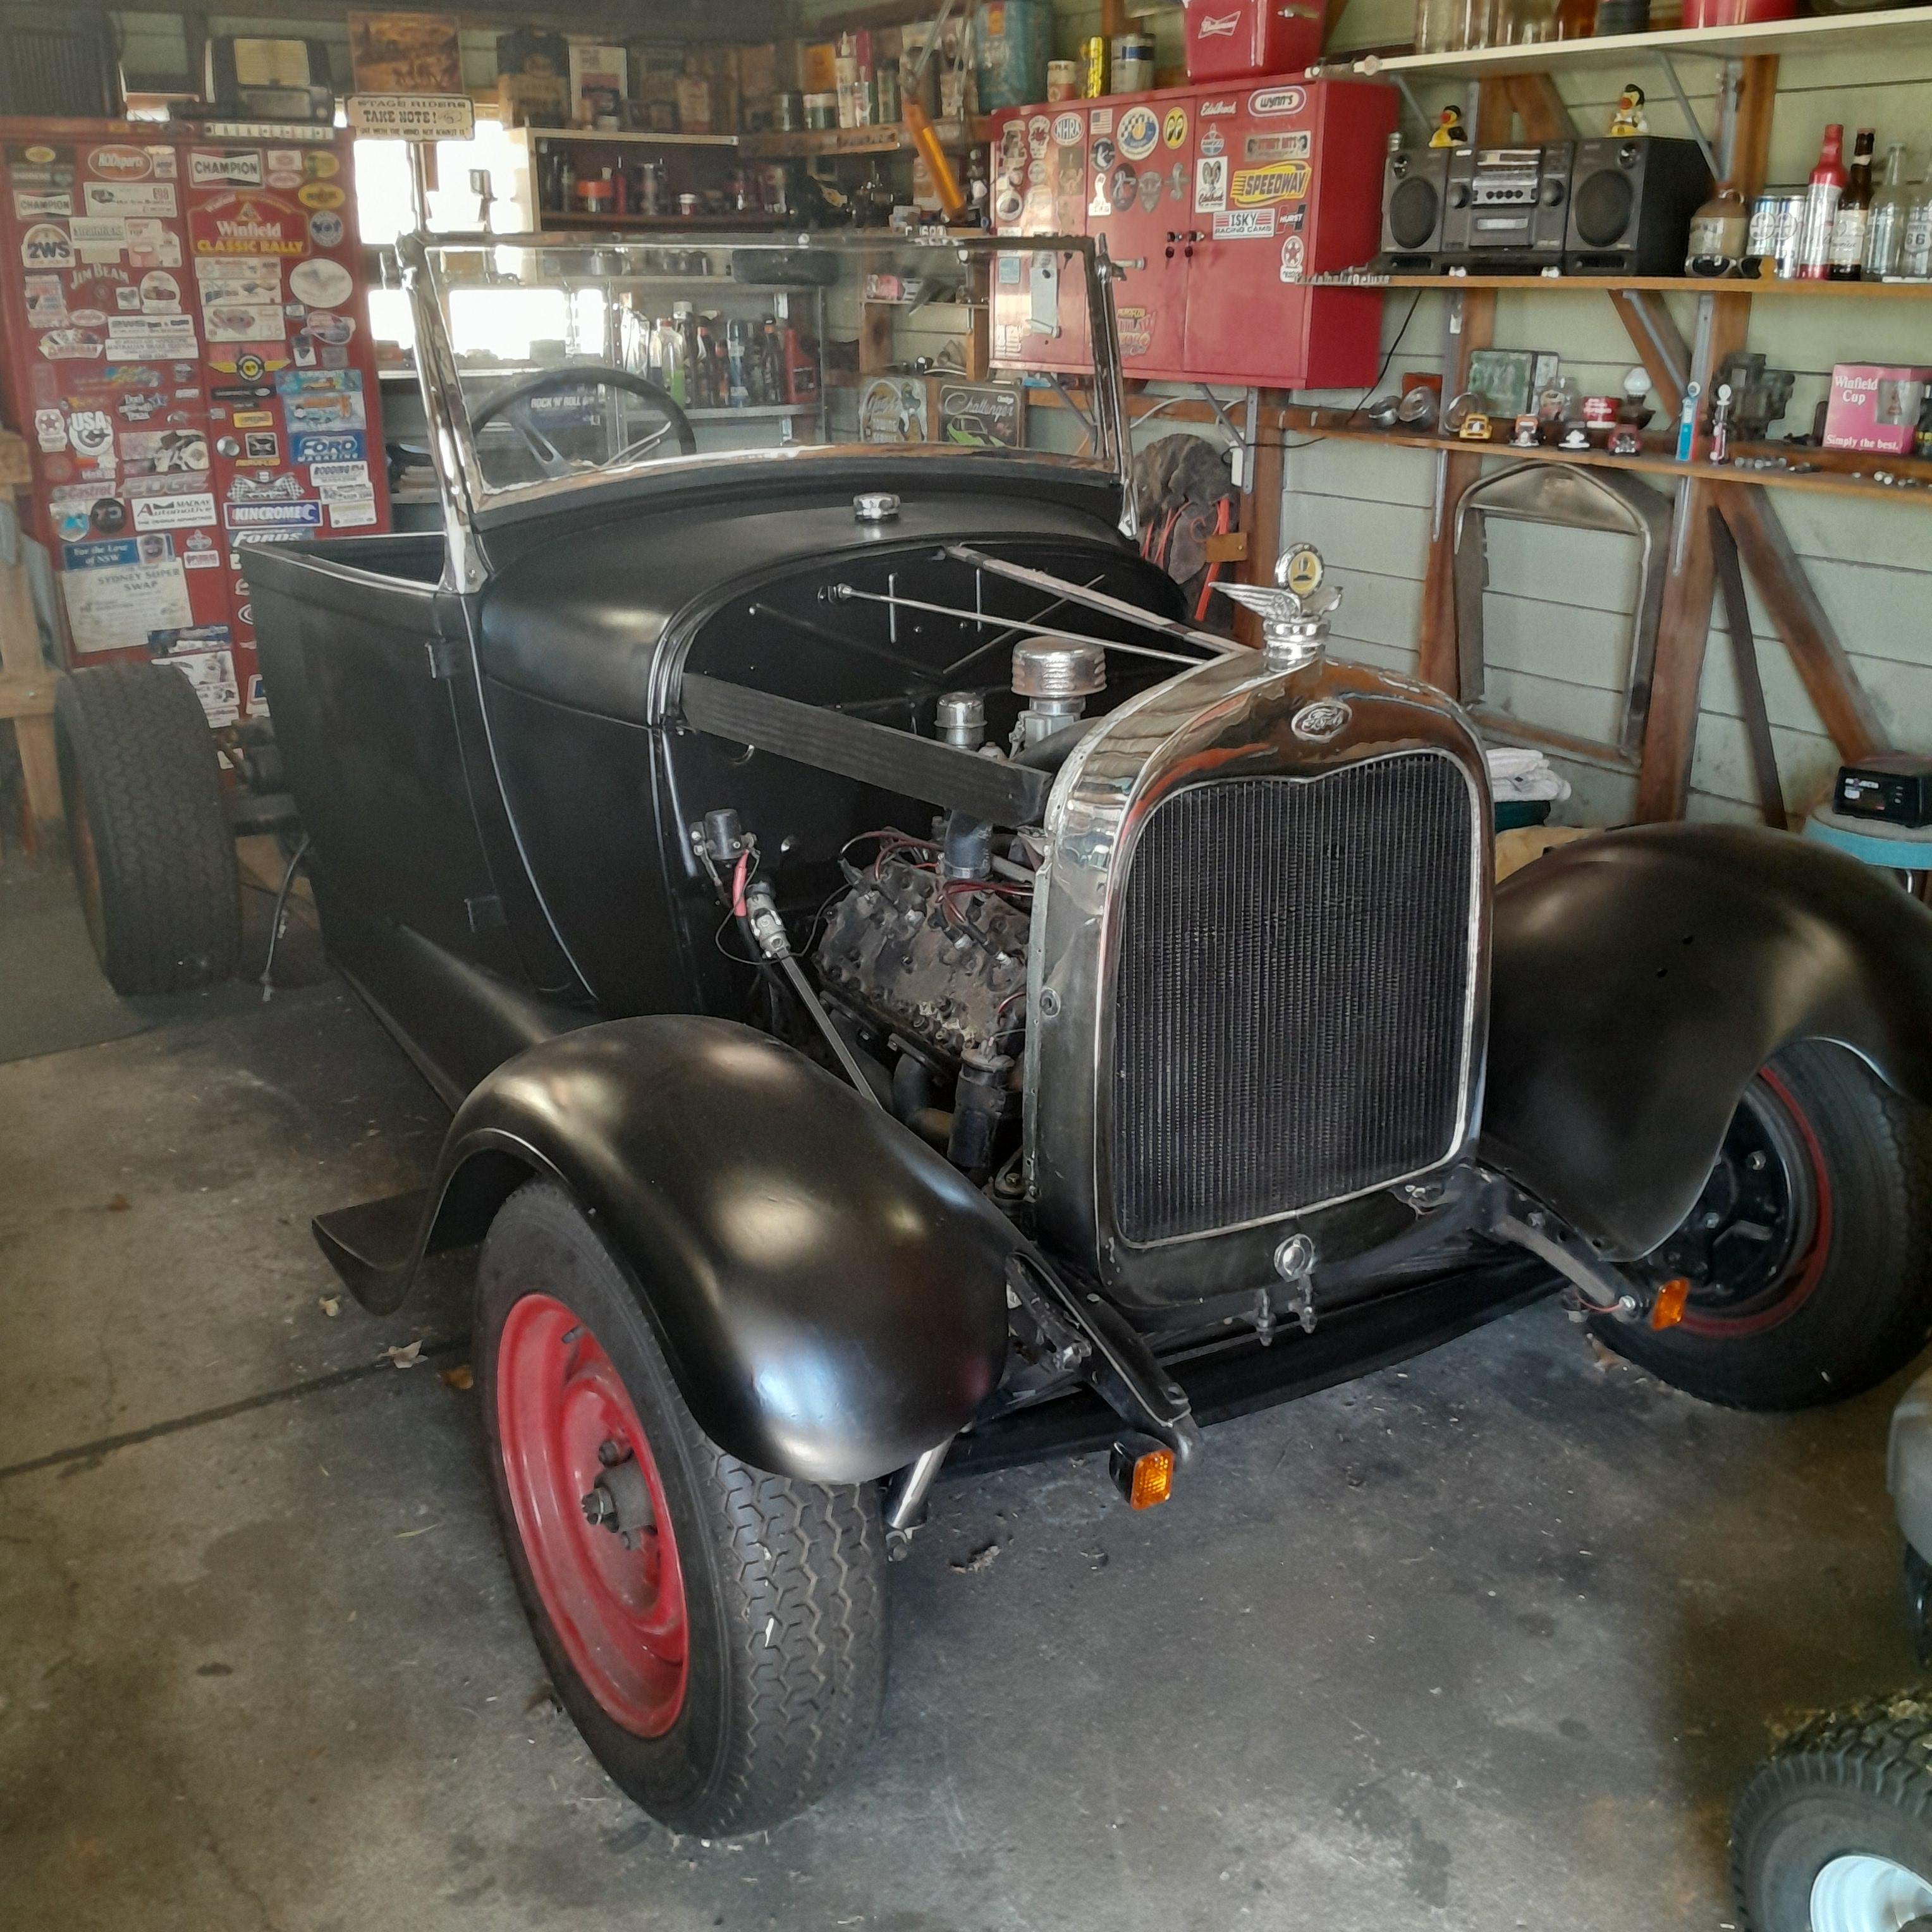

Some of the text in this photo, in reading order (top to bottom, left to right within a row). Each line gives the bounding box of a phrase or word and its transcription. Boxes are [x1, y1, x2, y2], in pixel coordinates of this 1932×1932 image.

[357, 100, 407, 108] STAGE
[363, 110, 437, 124] TAKE NOTE!
[1055, 118, 1080, 139] NHRA
[194, 161, 258, 174] CHAMPION
[1245, 172, 1306, 196] SPEEDWAY
[20, 200, 70, 210] CHAMPION
[1231, 212, 1257, 227] ISKY
[1280, 214, 1303, 223] HURST
[216, 220, 281, 237] Winfield
[197, 239, 304, 253] CLASSIC RALLY
[1905, 233, 1926, 245] 66
[27, 241, 70, 259] 2WS
[71, 262, 130, 290] JIM BEAM
[1835, 375, 1878, 391] Winfield
[531, 397, 553, 408] ROCK
[563, 396, 581, 406] ROLL
[1842, 390, 1867, 406] Cup
[945, 391, 1014, 423] Challenger
[71, 410, 107, 431] USA
[299, 436, 358, 456] FORD
[1826, 434, 1900, 451] Simply the best.
[298, 453, 358, 463] MAGAZINE
[68, 484, 112, 499] Castrol
[126, 473, 210, 497] EDGE
[176, 499, 211, 508] MACKAY
[232, 506, 303, 521] KINCROME
[233, 531, 303, 547] FORDS
[73, 547, 90, 556] For
[90, 546, 106, 554] the
[85, 554, 121, 566] of NSW
[98, 568, 181, 585] SYDNEY SUPER
[123, 580, 159, 592] SWAP
[1301, 707, 1344, 731] Ford
